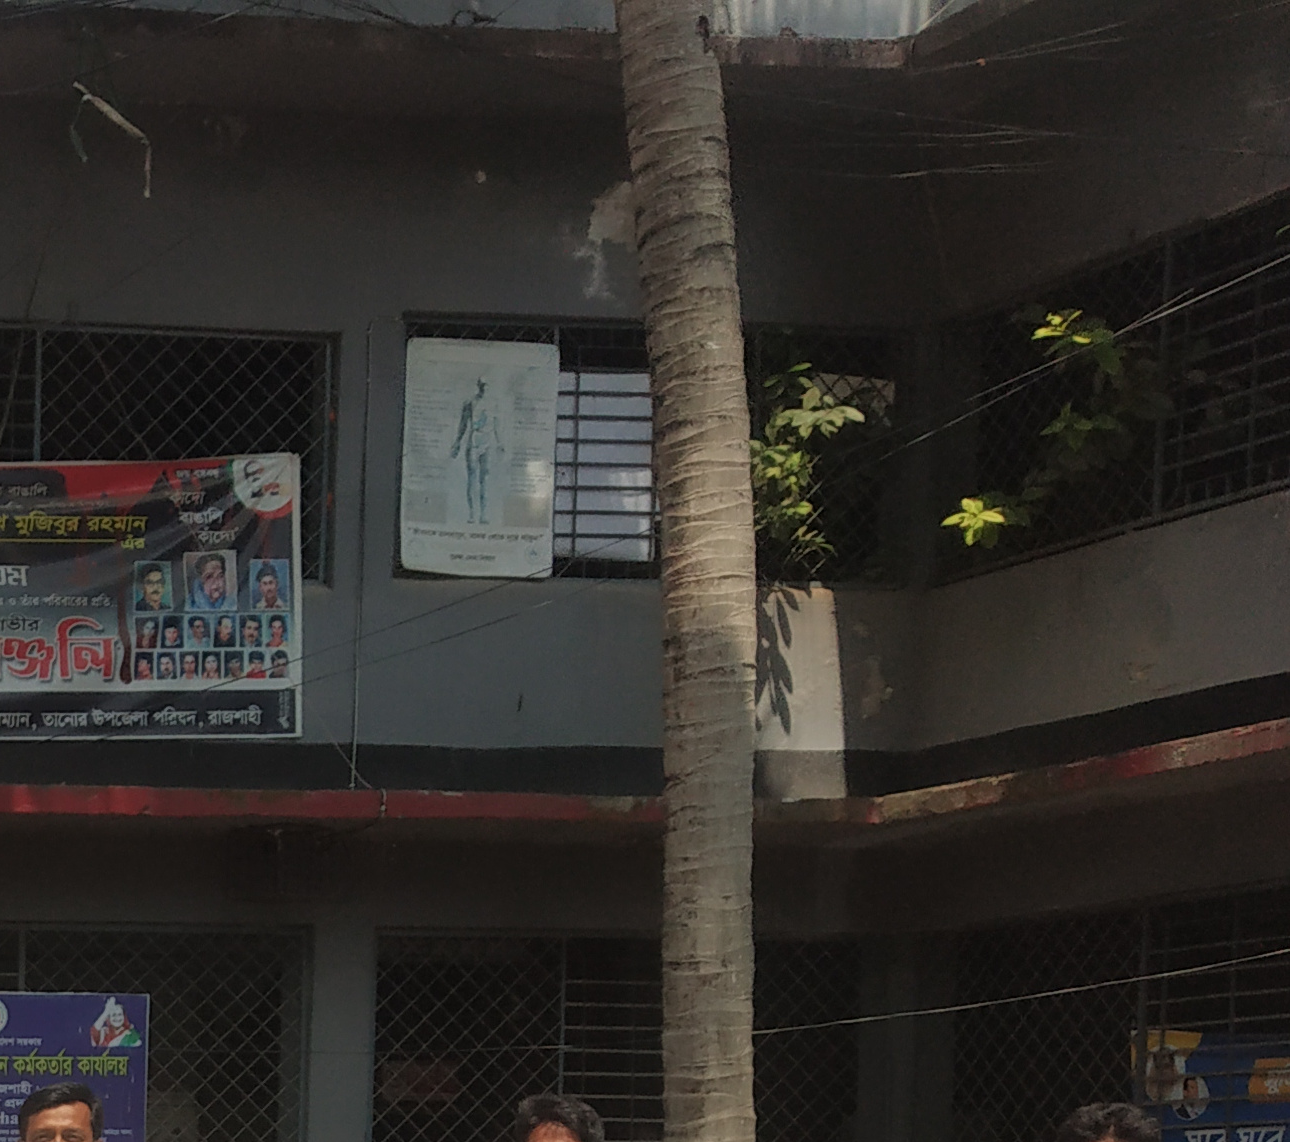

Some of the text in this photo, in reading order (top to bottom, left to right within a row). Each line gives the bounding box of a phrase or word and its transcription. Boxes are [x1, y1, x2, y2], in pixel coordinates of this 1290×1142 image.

[12, 512, 83, 537] মুজিবুর
[83, 510, 148, 534] রহমান
[13, 1050, 72, 1077] কর্মকর্তার
[77, 1050, 129, 1077] কার্যালয়
